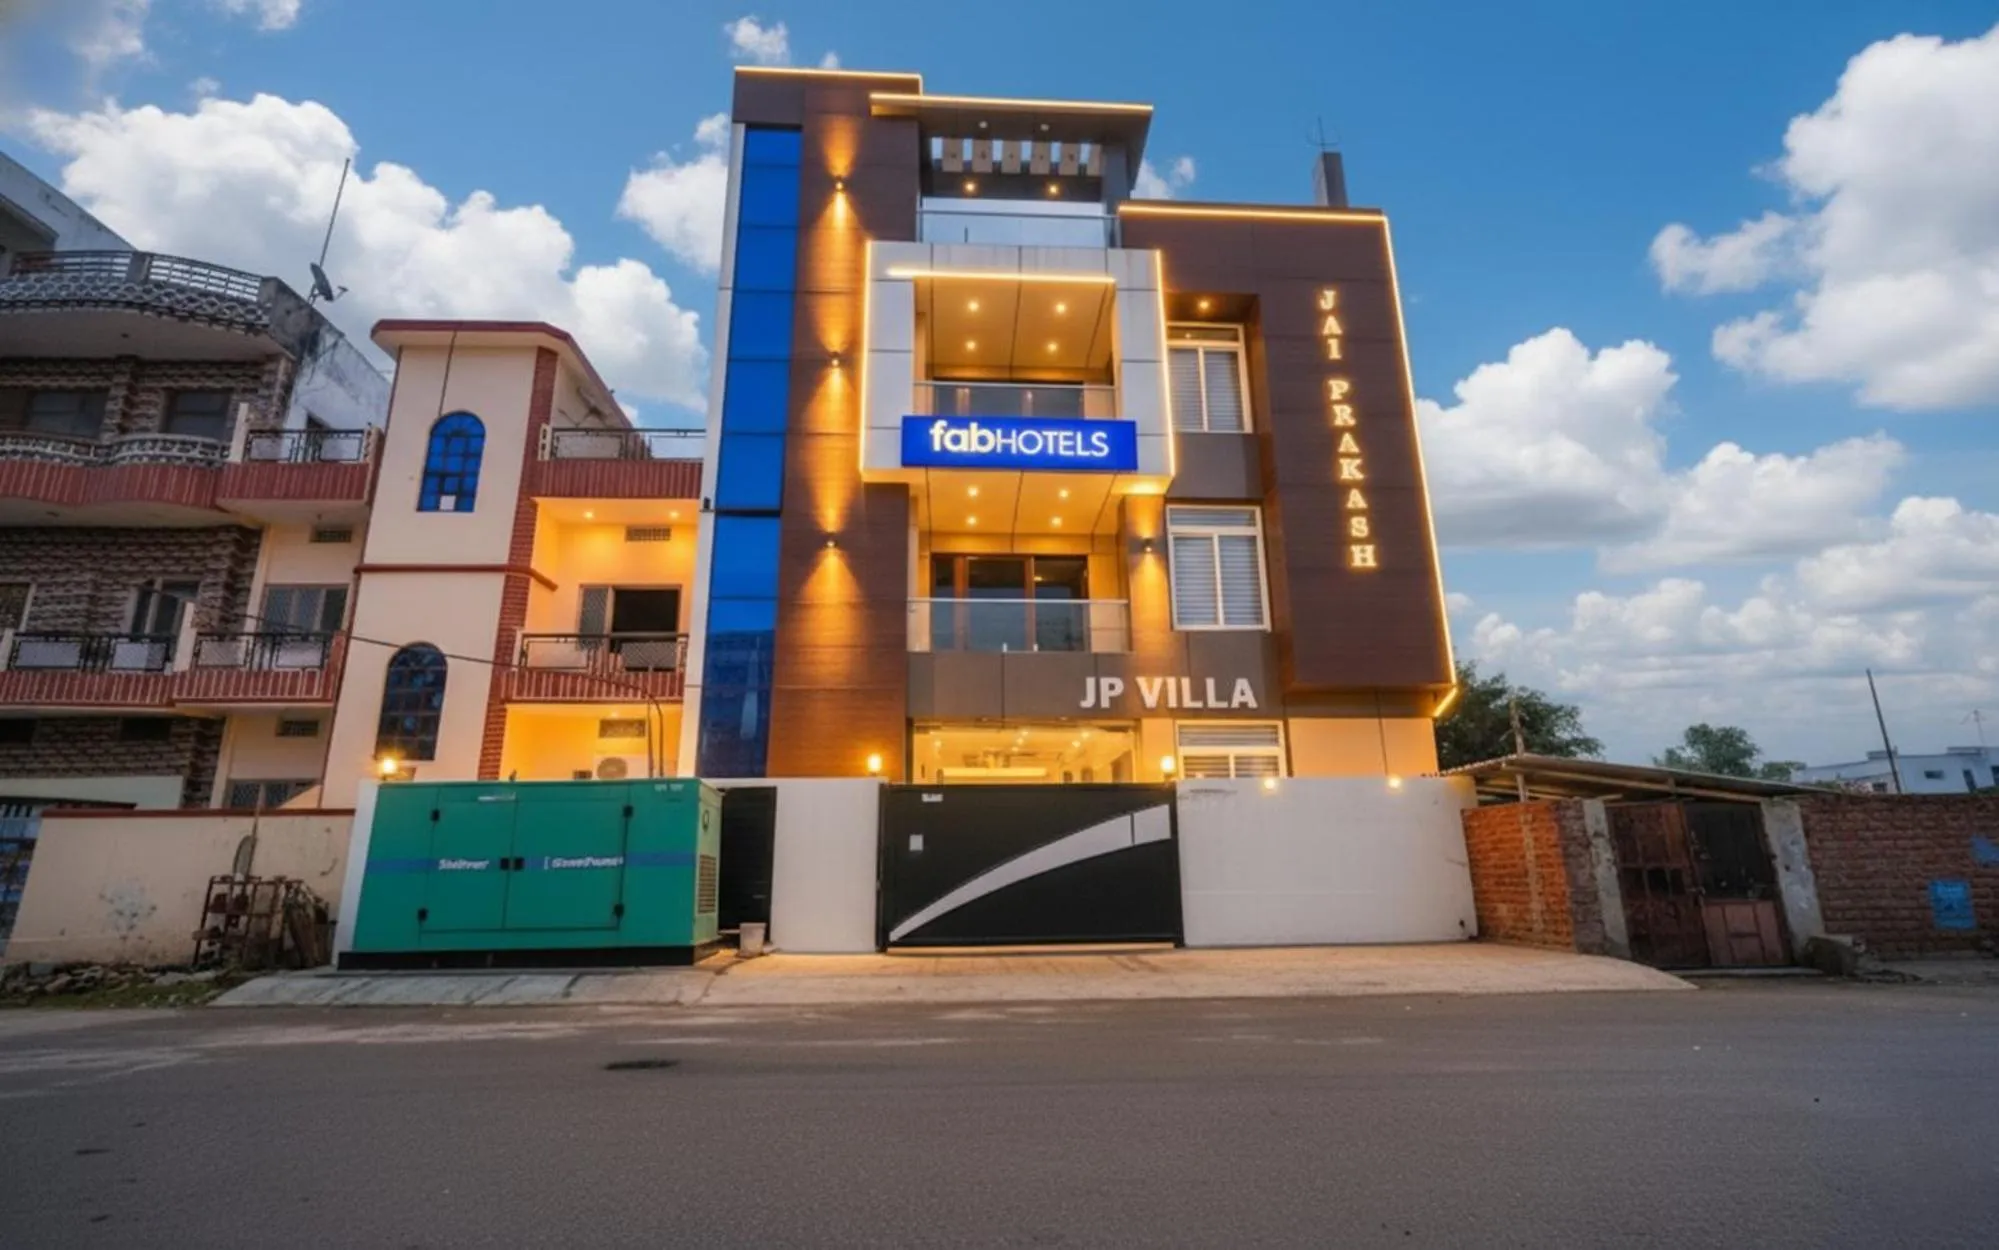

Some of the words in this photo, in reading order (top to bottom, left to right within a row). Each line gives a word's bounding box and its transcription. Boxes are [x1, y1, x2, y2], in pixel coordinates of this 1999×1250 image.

[1319, 290, 1342, 360] JAI
[930, 419, 1110, 457] fabHOTELS
[1328, 380, 1377, 567] PRAKASH
[1079, 676, 1125, 709] JP
[1135, 676, 1258, 709] VILLA
